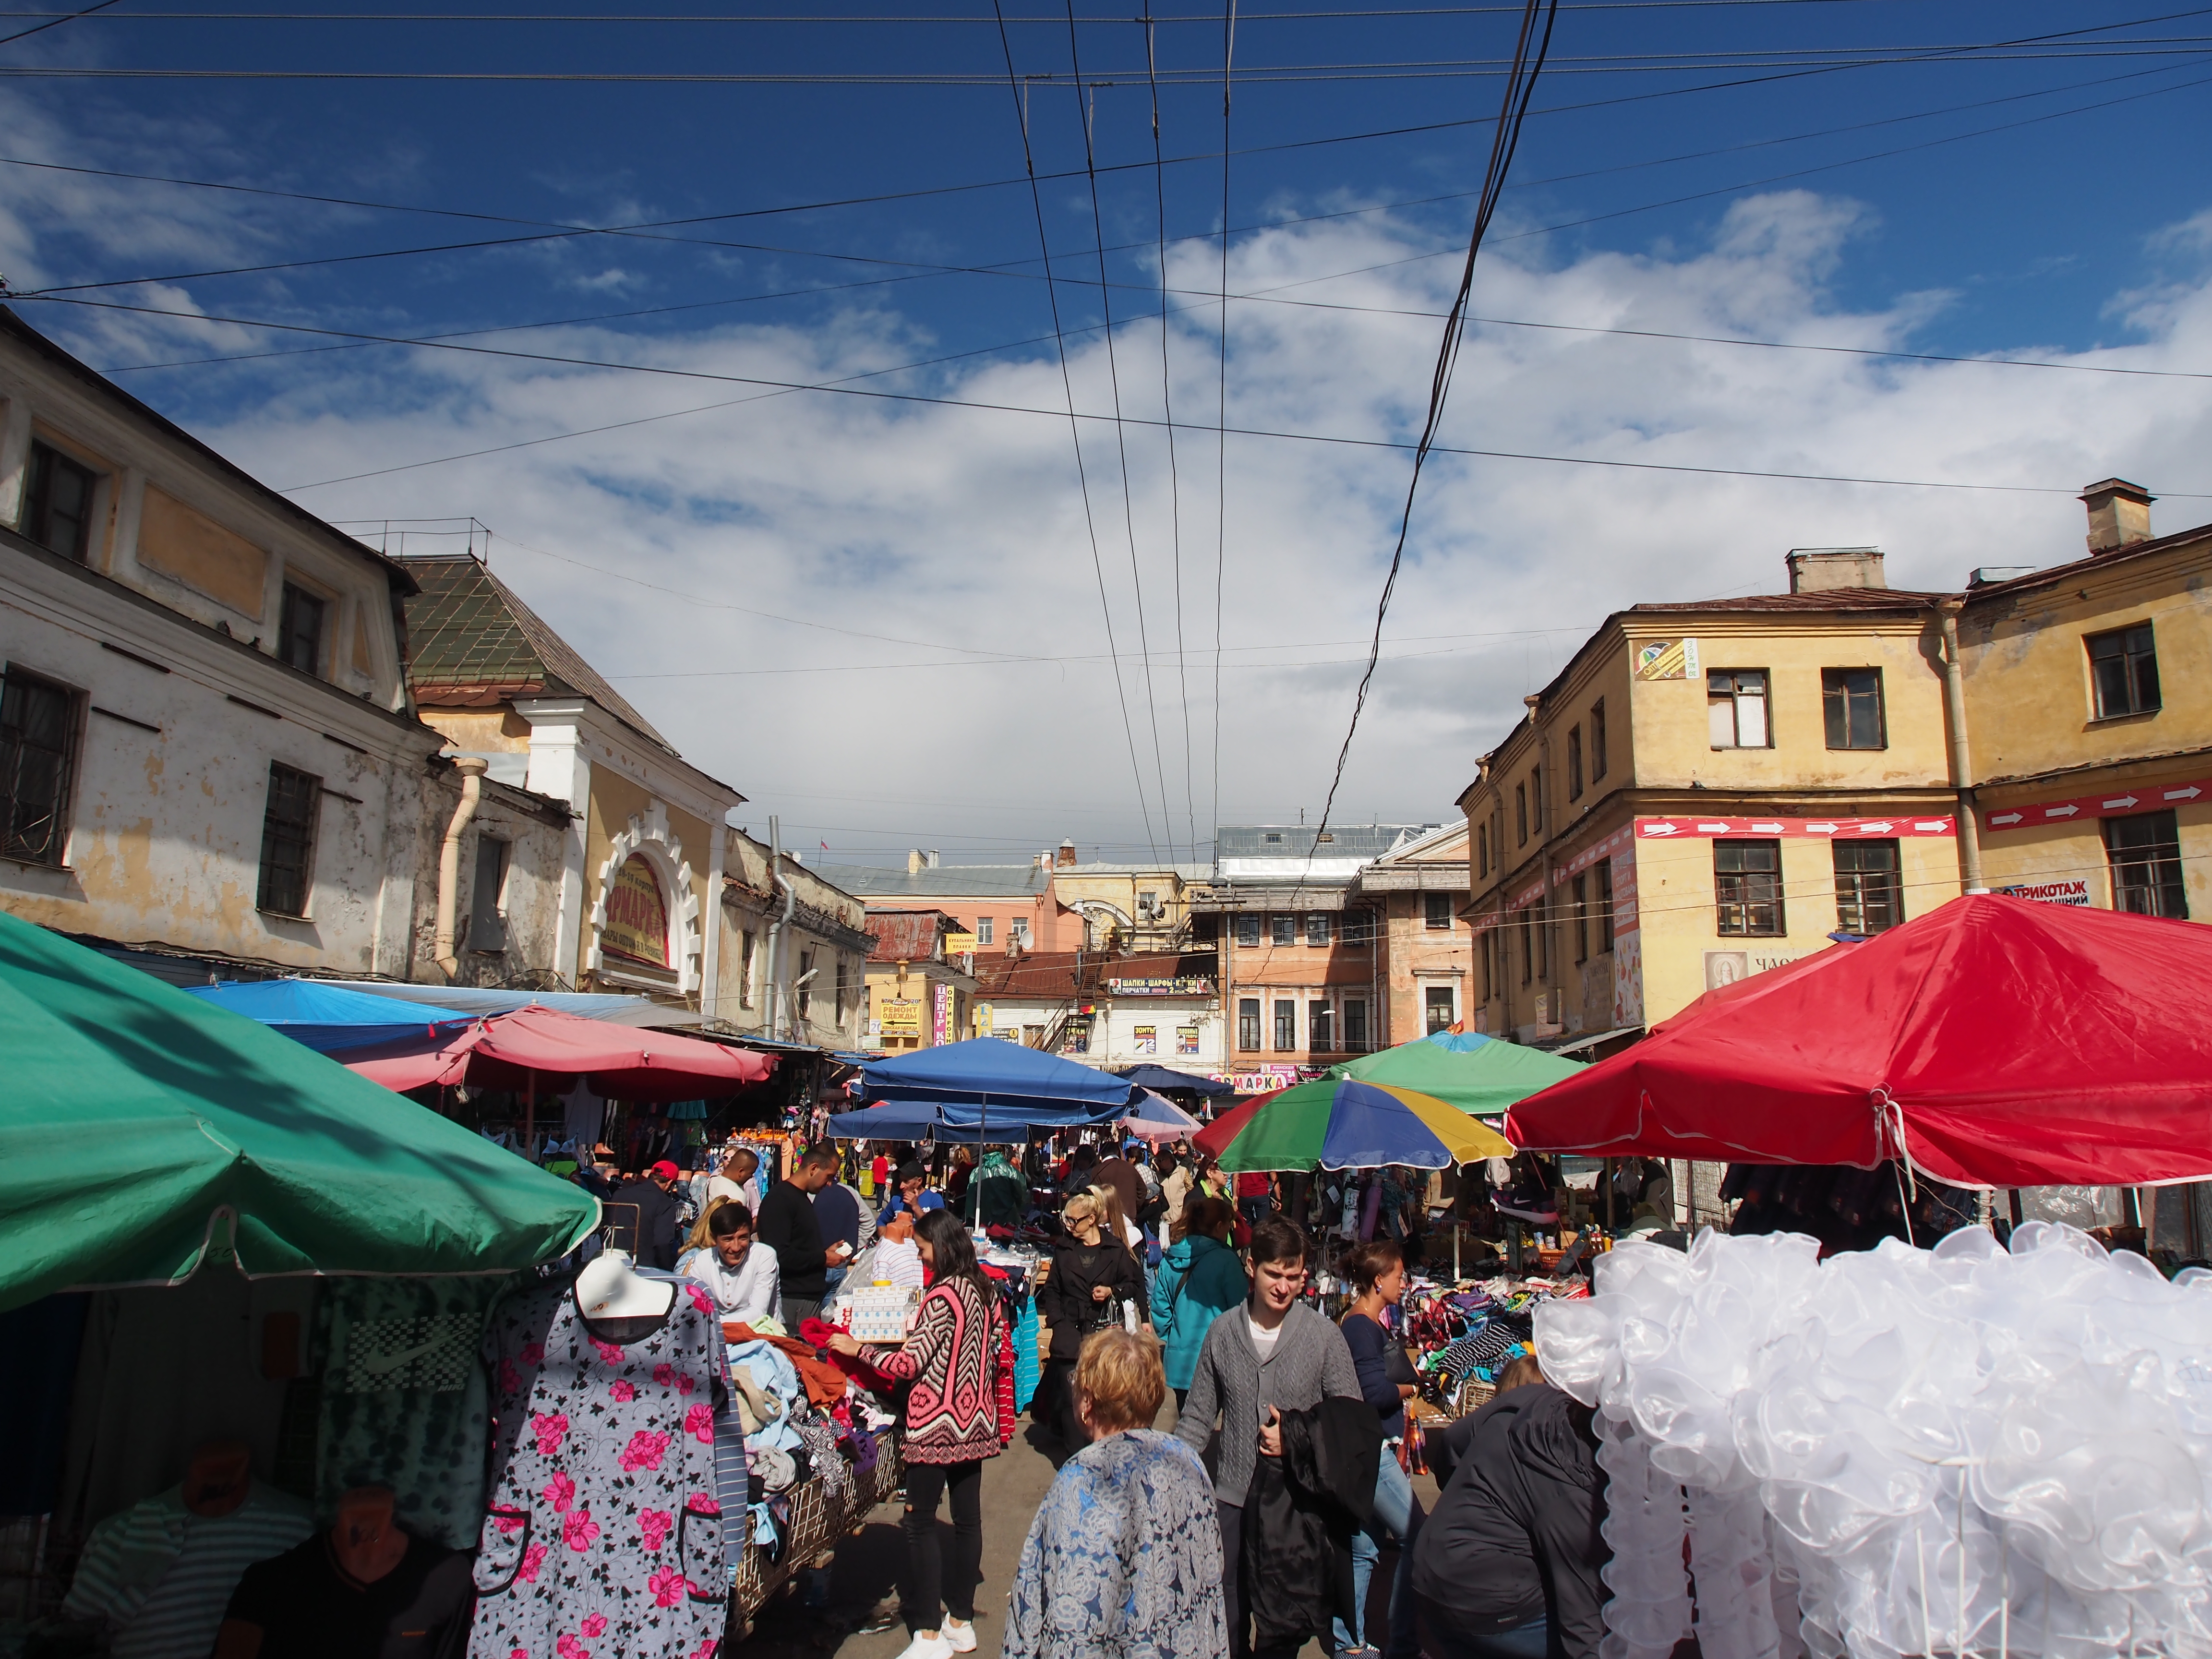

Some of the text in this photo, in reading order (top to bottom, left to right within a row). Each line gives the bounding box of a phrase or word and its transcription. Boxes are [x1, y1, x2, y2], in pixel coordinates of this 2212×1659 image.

[2014, 881, 2086, 899] ТРИКОТАЖ
[2043, 894, 2088, 905] АШНИЙ
[936, 986, 946, 1026] ЦЕНТР
